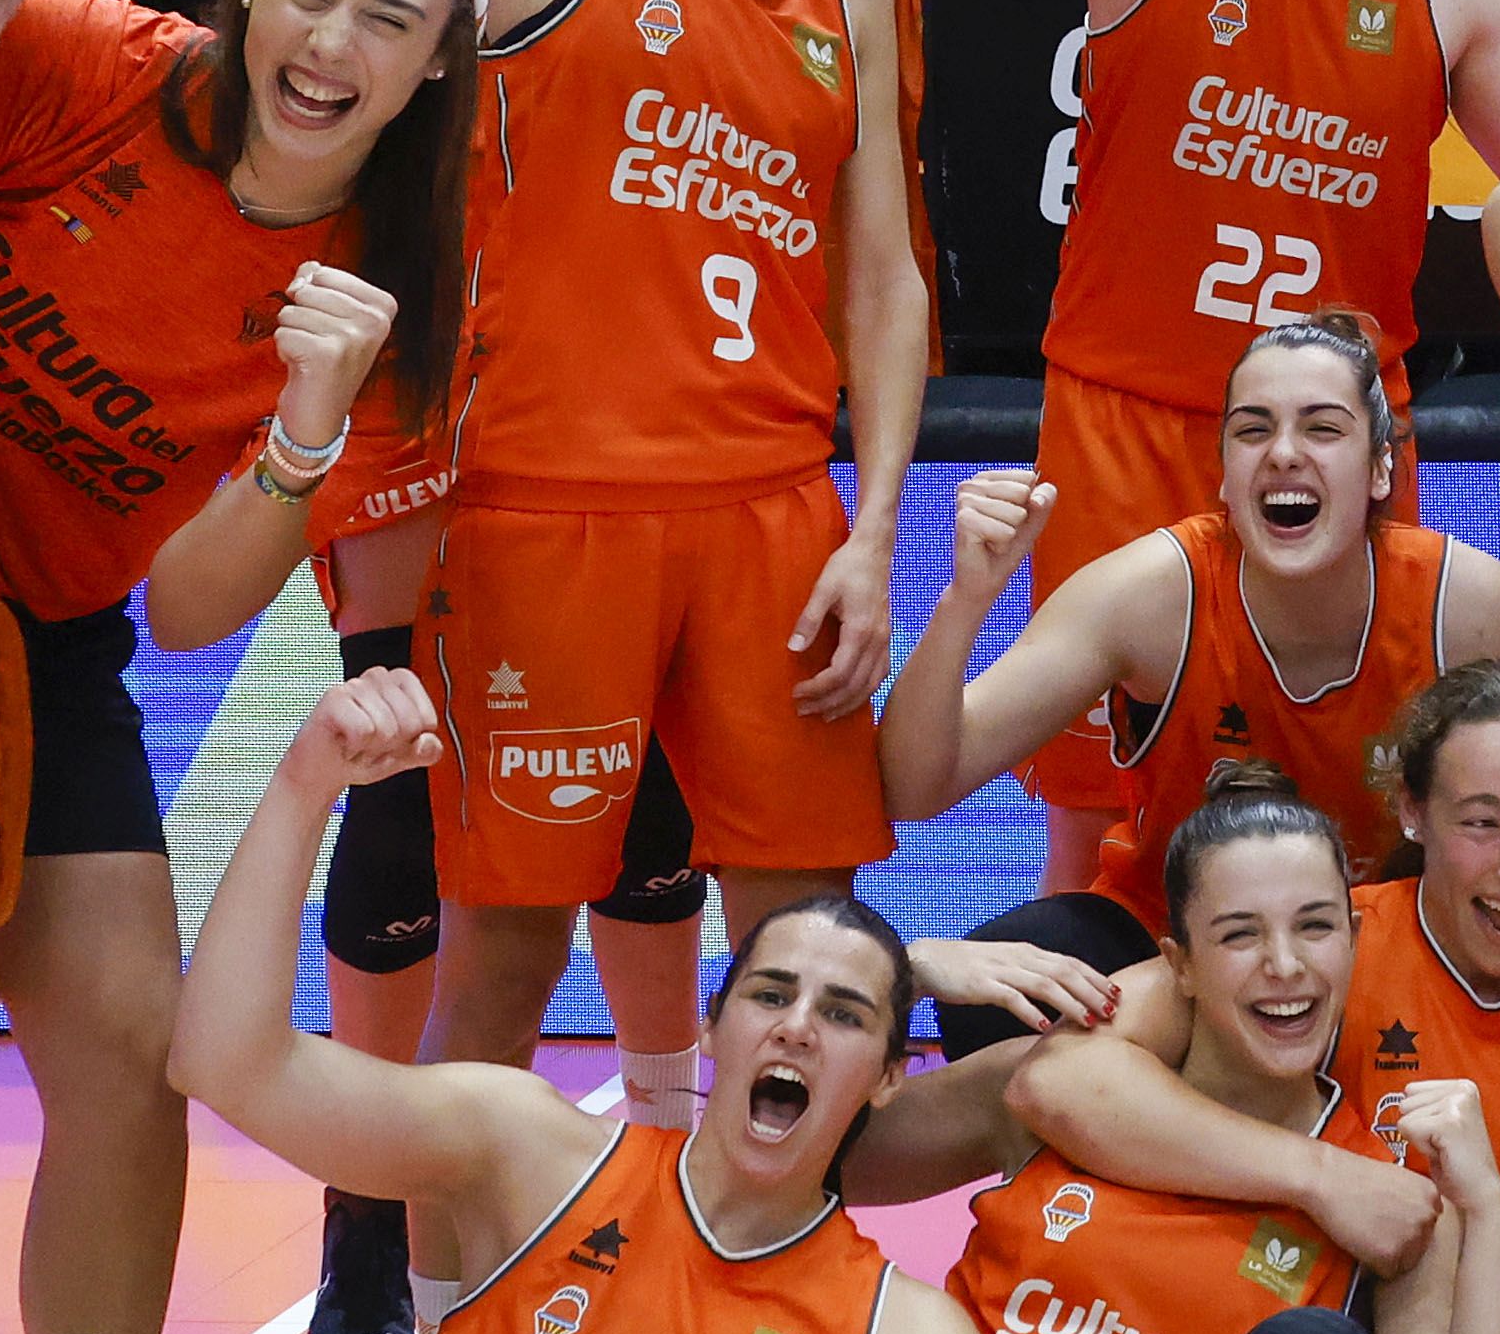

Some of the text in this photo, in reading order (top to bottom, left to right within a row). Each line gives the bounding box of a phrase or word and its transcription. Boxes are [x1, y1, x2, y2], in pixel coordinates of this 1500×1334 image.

[624, 87, 797, 188] Cultura
[1187, 74, 1389, 161] Cultura del
[610, 147, 818, 257] Esfuerzo
[1171, 121, 1380, 209] Esfuerzo
[701, 253, 759, 361] 9
[1193, 222, 1322, 328] 22
[125, 402, 198, 466] del
[500, 741, 632, 777] PULEVA
